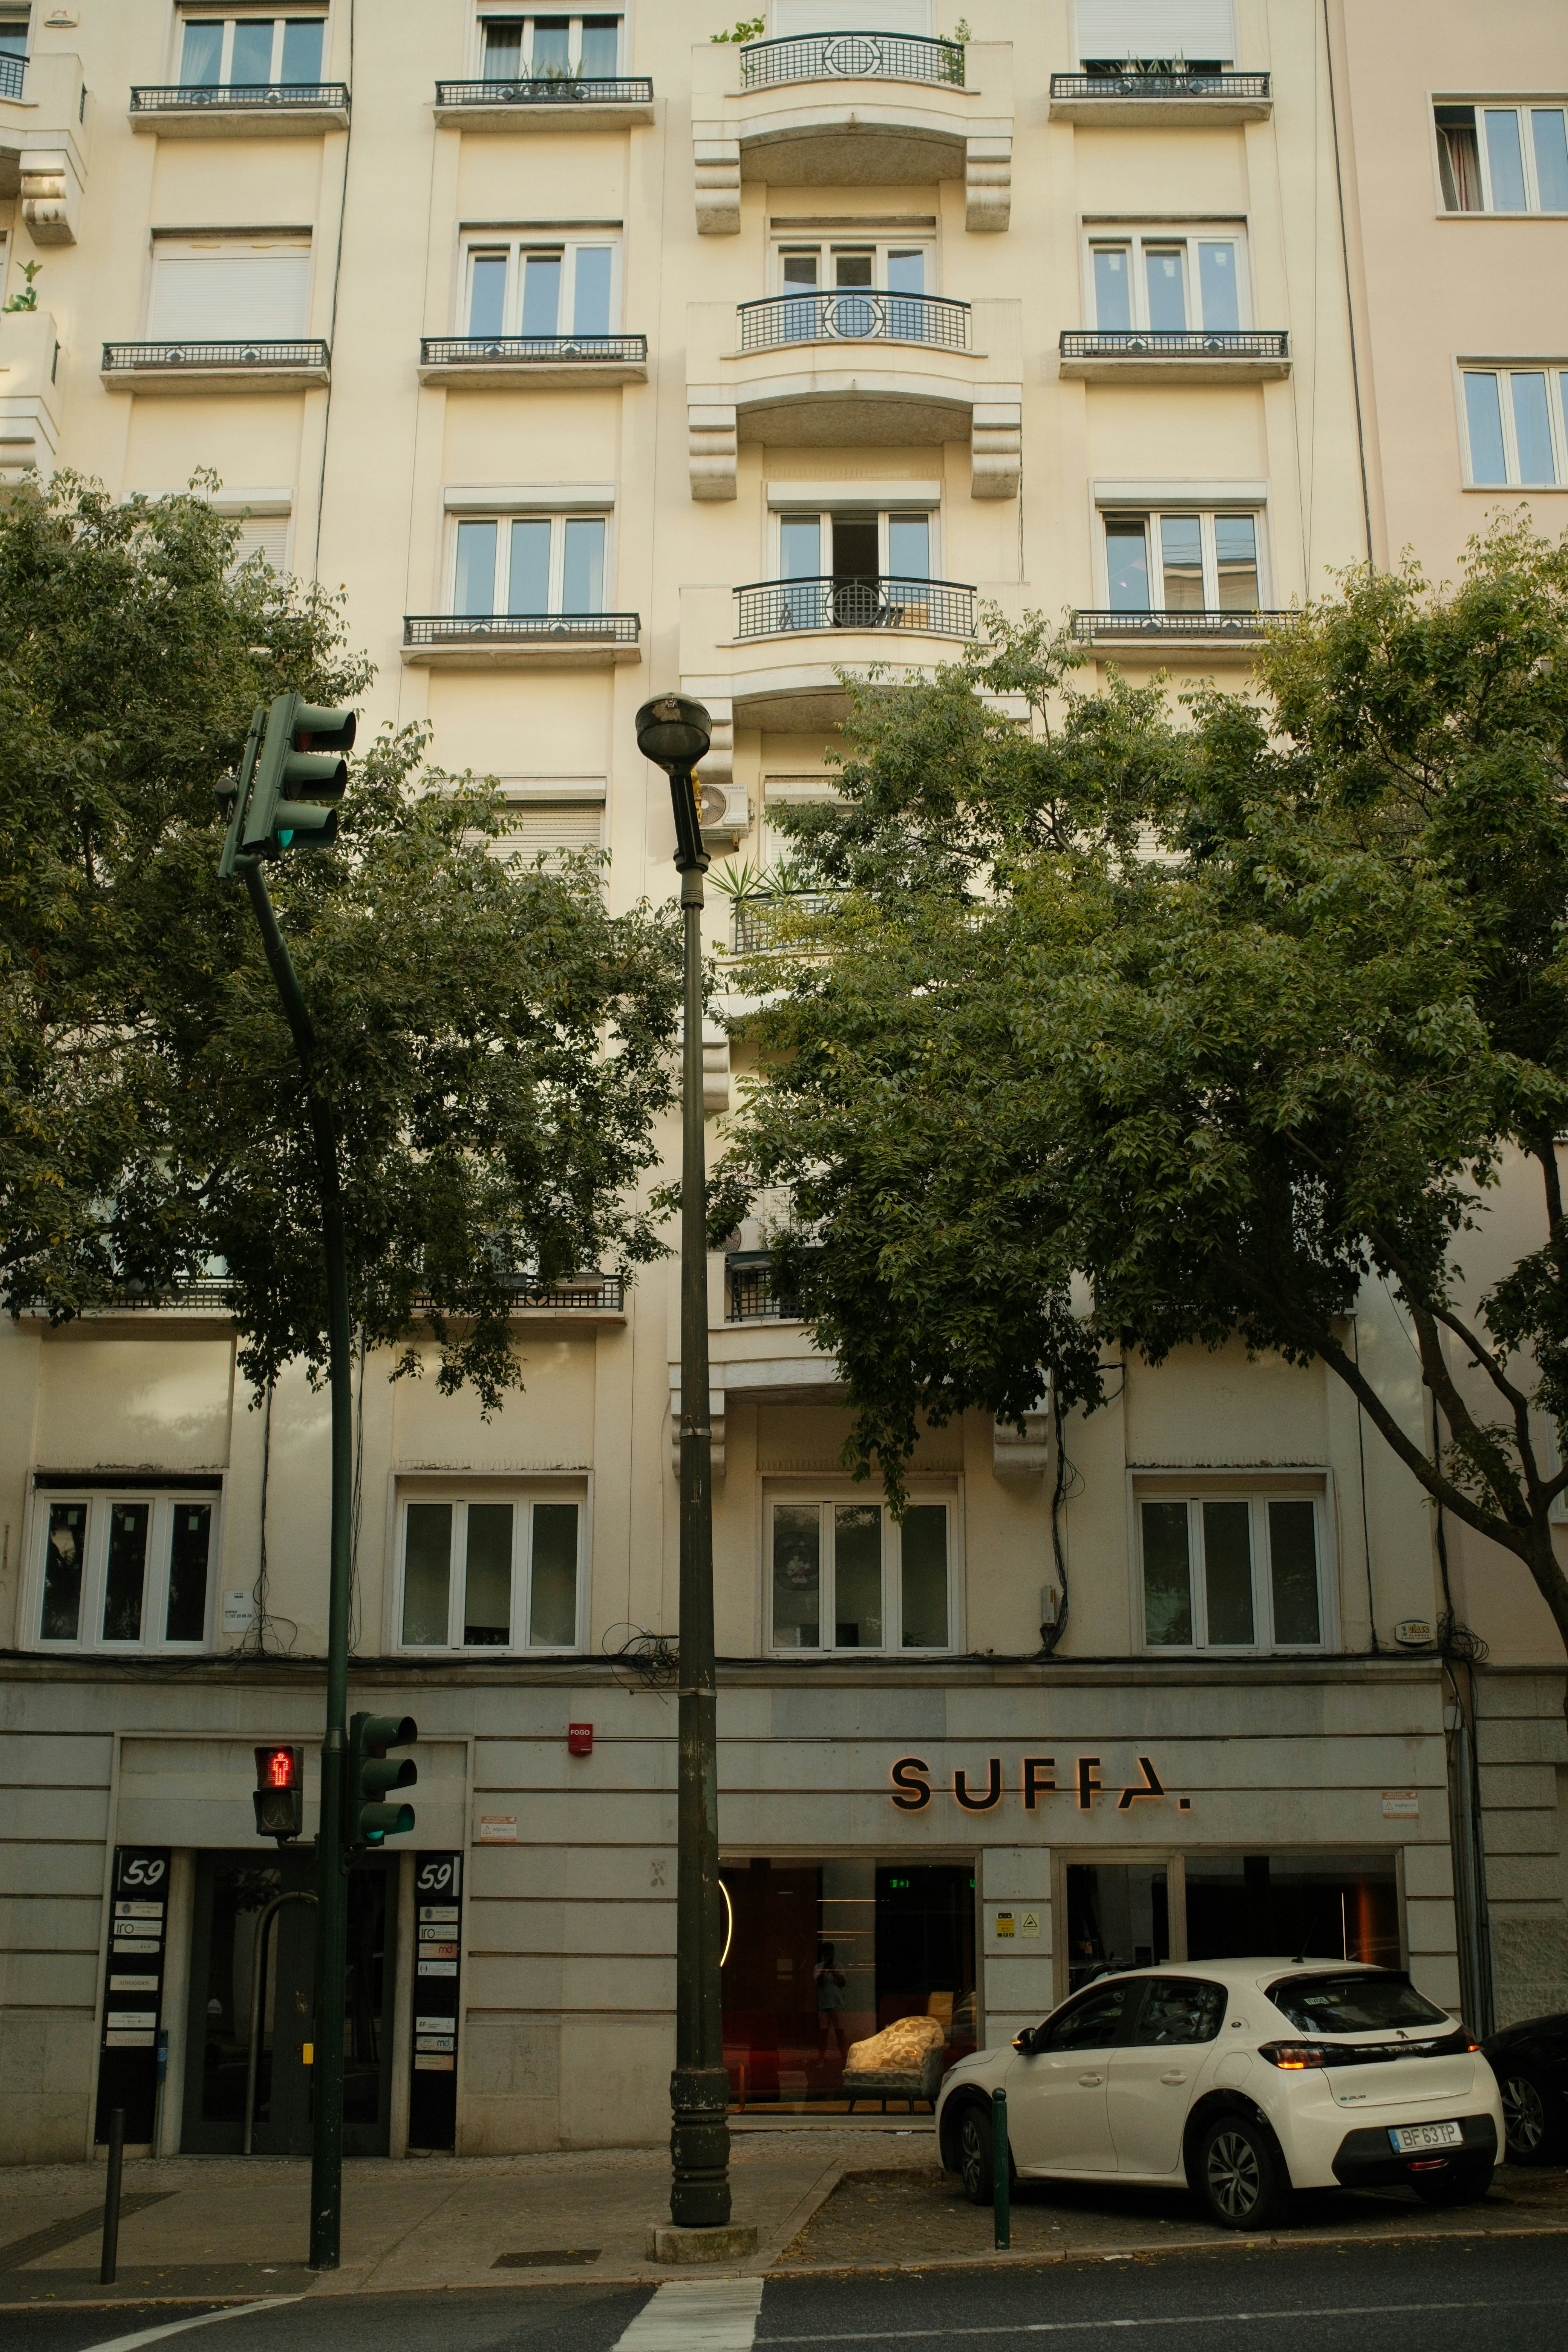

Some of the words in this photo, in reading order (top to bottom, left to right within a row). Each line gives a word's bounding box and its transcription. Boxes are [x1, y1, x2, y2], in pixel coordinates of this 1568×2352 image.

[123, 1859, 165, 1885] 59
[417, 1864, 452, 1890] 59
[1401, 2129, 1419, 2146] BF
[1422, 2127, 1439, 2144] 63
[1438, 2124, 1455, 2141] TP
